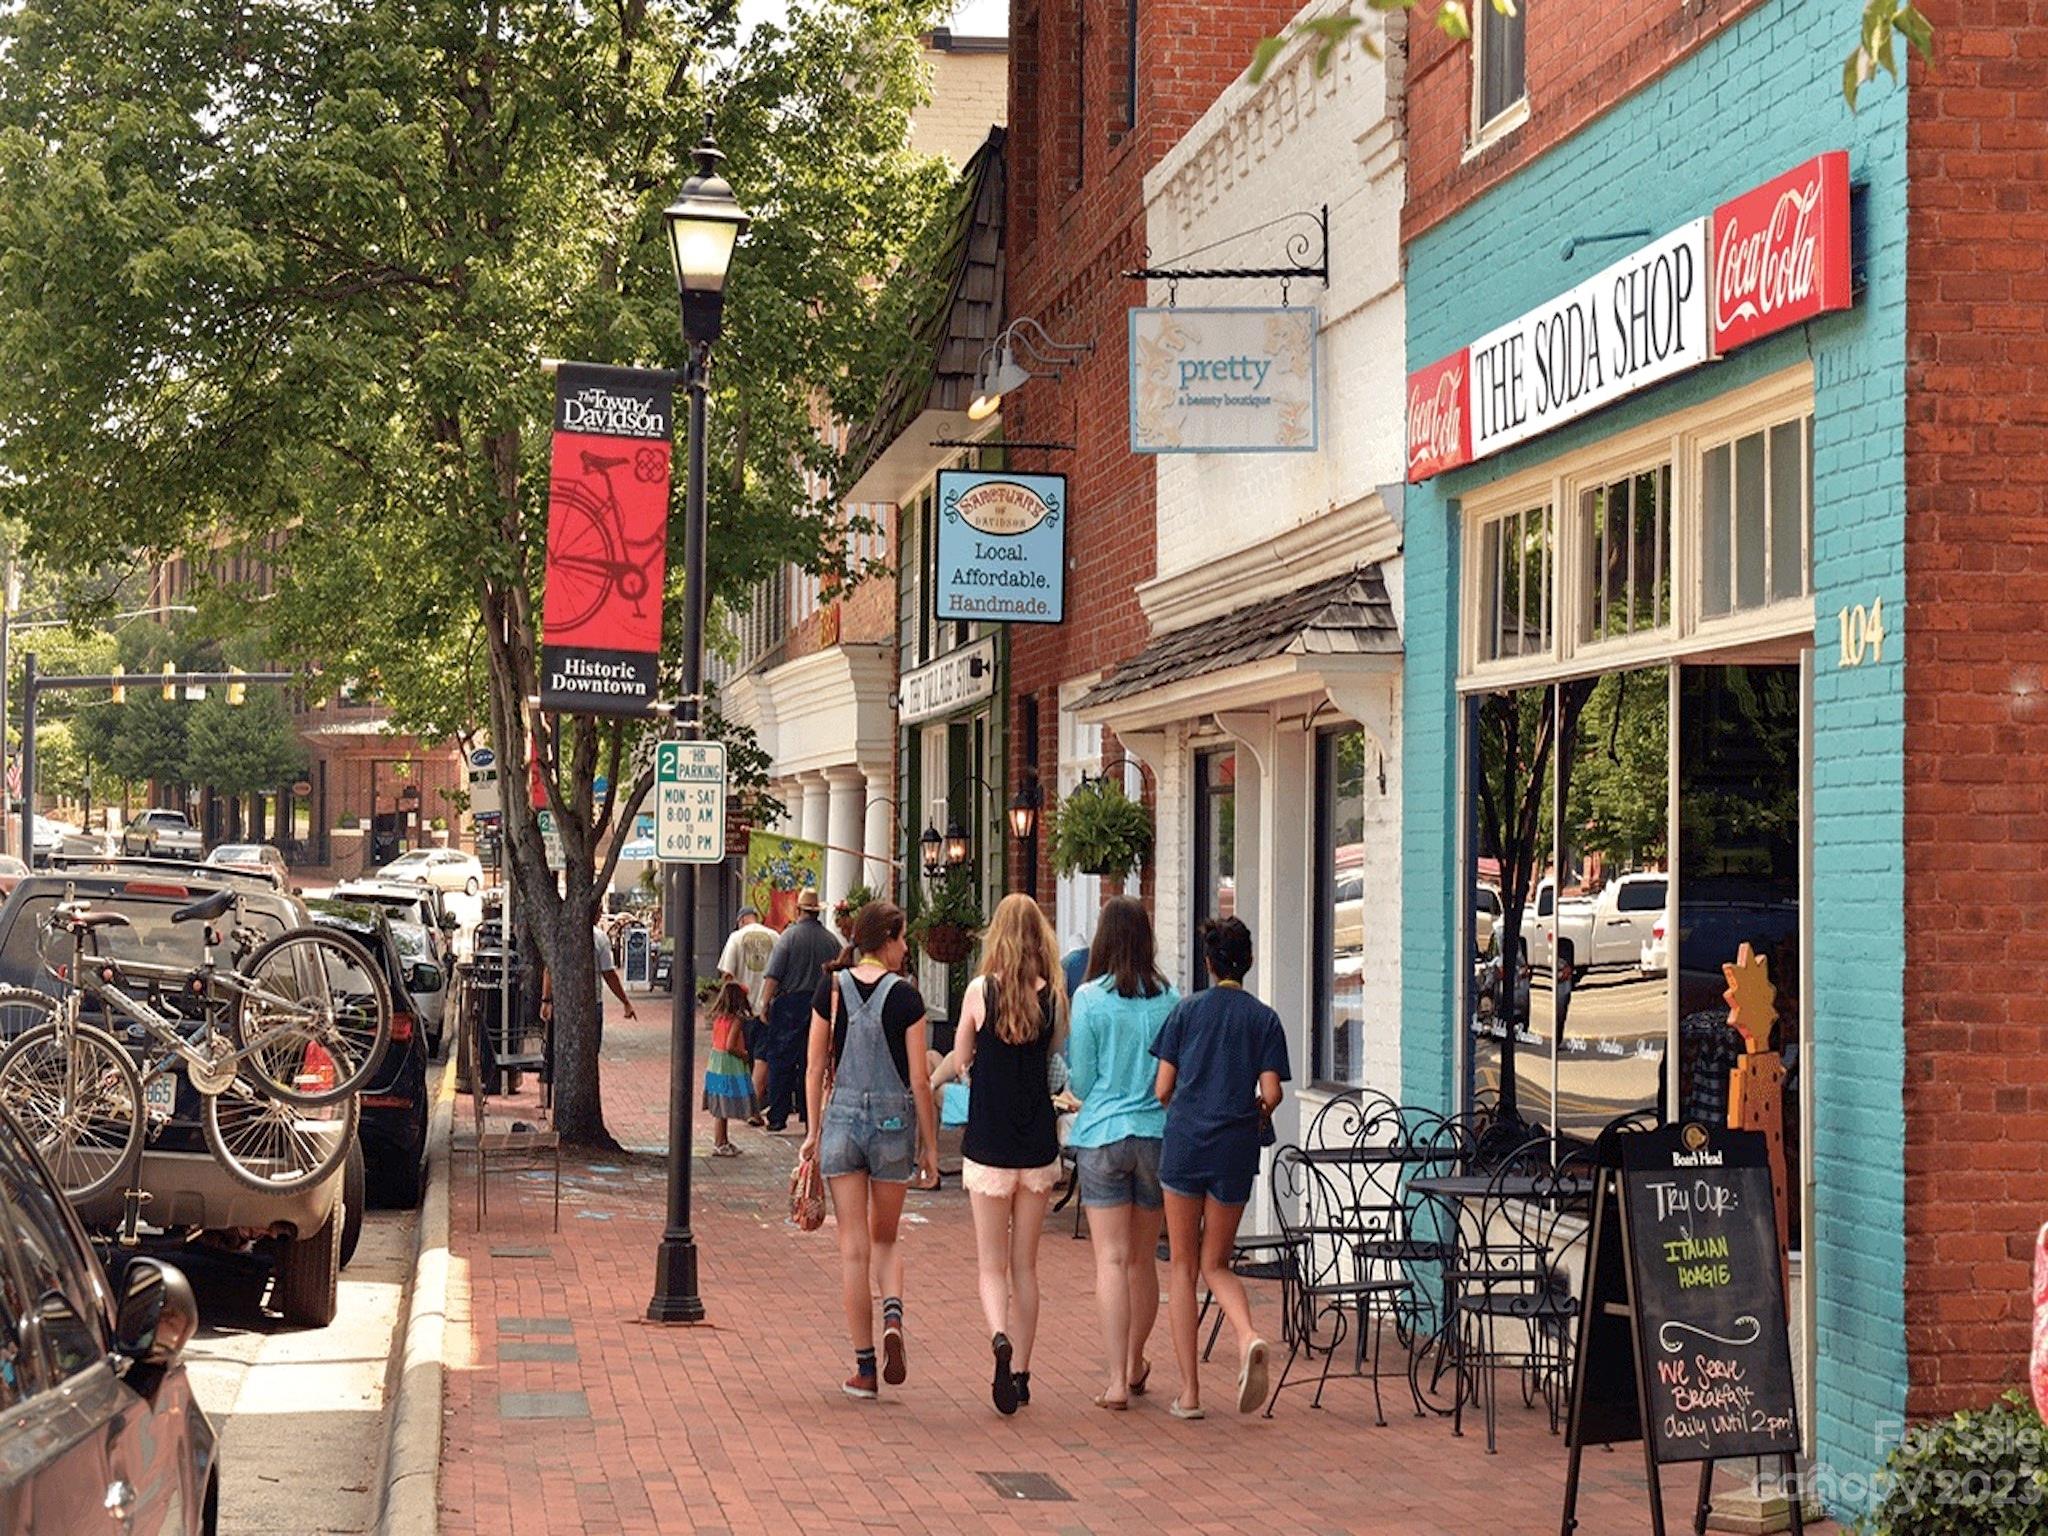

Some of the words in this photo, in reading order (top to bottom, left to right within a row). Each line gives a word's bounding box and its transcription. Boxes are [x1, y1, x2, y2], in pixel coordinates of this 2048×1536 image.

[1716, 156, 1823, 332] Coca-Cola
[1475, 332, 1527, 441] THE
[1535, 293, 1604, 416] SODA
[1613, 243, 1694, 379] SHOP
[1177, 355, 1271, 390] pretty
[589, 388, 640, 412] Town
[636, 398, 654, 415] of
[1224, 393, 1271, 408] boutique
[563, 397, 664, 432] Davidson
[1408, 365, 1464, 467] Coca-Cola
[960, 488, 1045, 518] SANCTUARY
[976, 518, 1026, 528] DAVIDSON
[975, 542, 1027, 561] Local.
[951, 568, 1050, 589] Affordable.
[949, 594, 1051, 615] Handmade.
[1838, 596, 1883, 667] 104
[564, 658, 636, 679] Historic
[552, 673, 646, 696] Downtown
[661, 751, 675, 774] 2
[693, 748, 706, 762] HR
[679, 764, 720, 779] PARKING
[664, 789, 686, 803] MON
[697, 789, 715, 804] SAT
[667, 807, 691, 822] 8:00
[698, 807, 713, 822] AM
[667, 835, 691, 850] 6:00
[697, 836, 712, 850] PM
[1700, 1150, 1723, 1166] Head
[1663, 1235, 1729, 1262] ITALIAN
[1678, 1264, 1730, 1289] HOAGIE
[1658, 1360, 1690, 1385] We
[1671, 1383, 1755, 1412] Breakfast
[1664, 1413, 1710, 1449] daily
[1711, 1411, 1749, 1433] until
